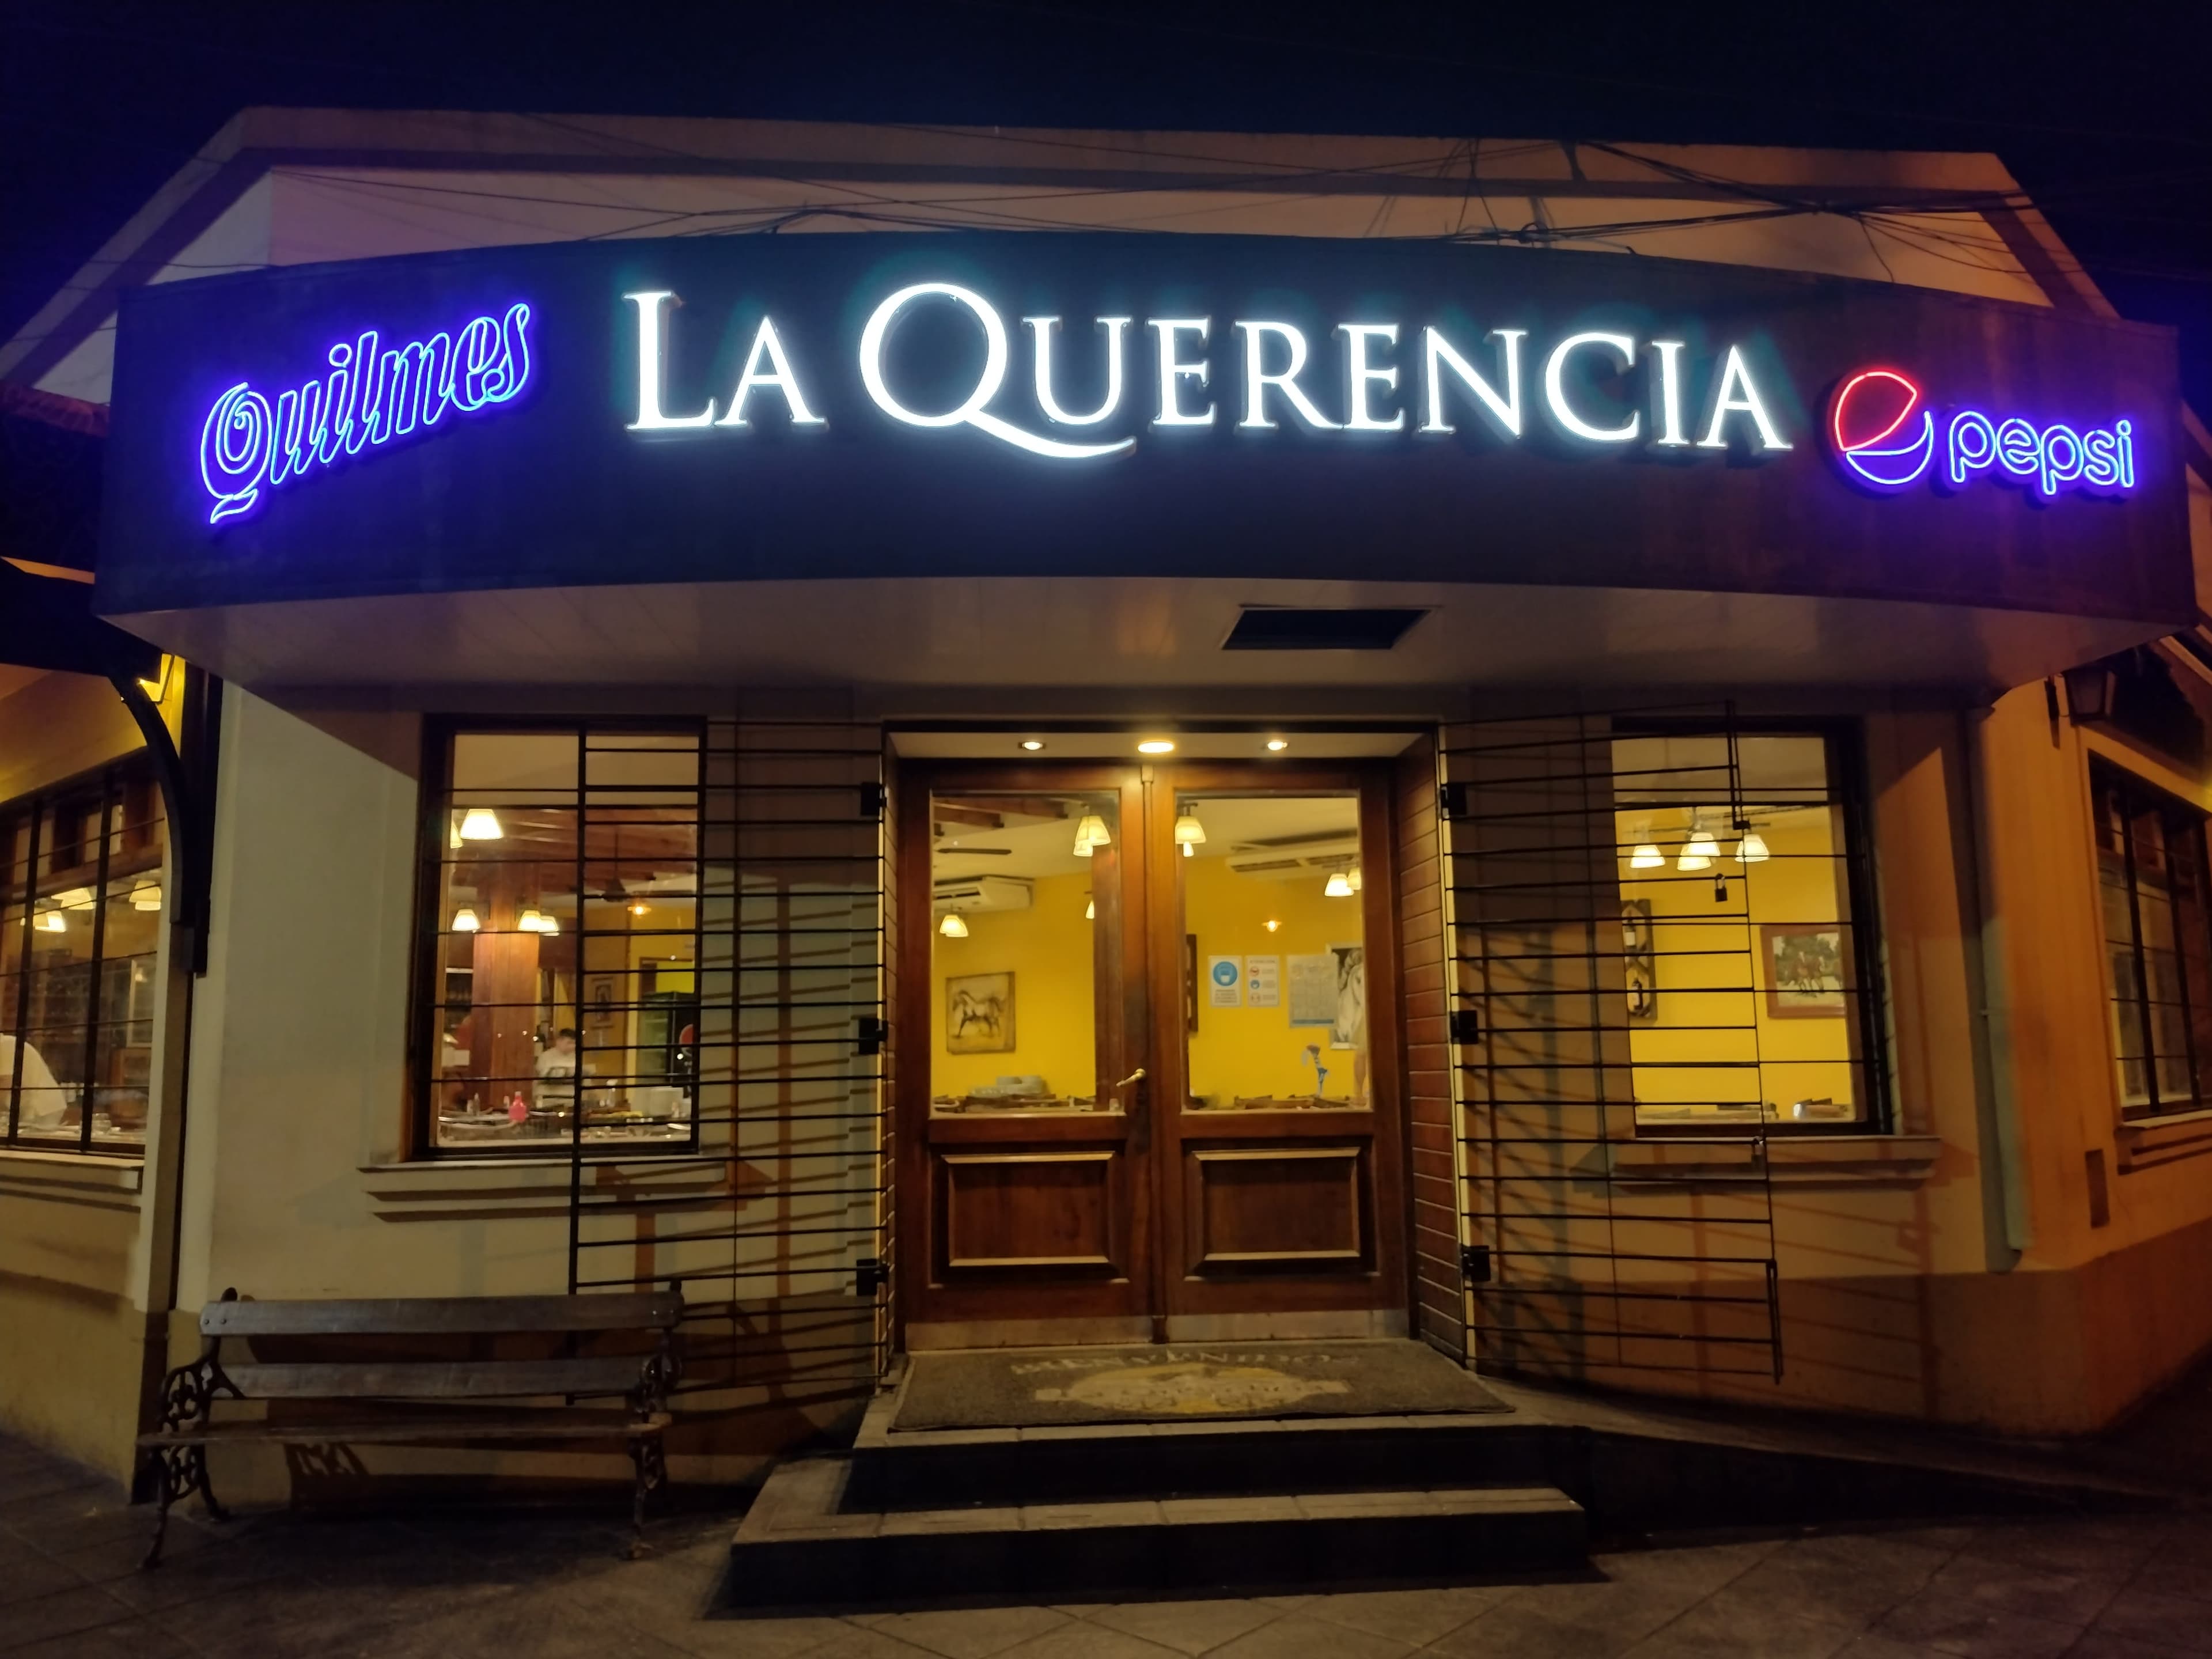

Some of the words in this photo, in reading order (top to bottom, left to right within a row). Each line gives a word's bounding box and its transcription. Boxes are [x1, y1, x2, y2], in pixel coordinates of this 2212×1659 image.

[200, 303, 530, 524] Quilmes
[623, 290, 826, 431] LA
[859, 282, 1793, 459] QUERENCIA
[1948, 410, 2135, 495] pepsi
